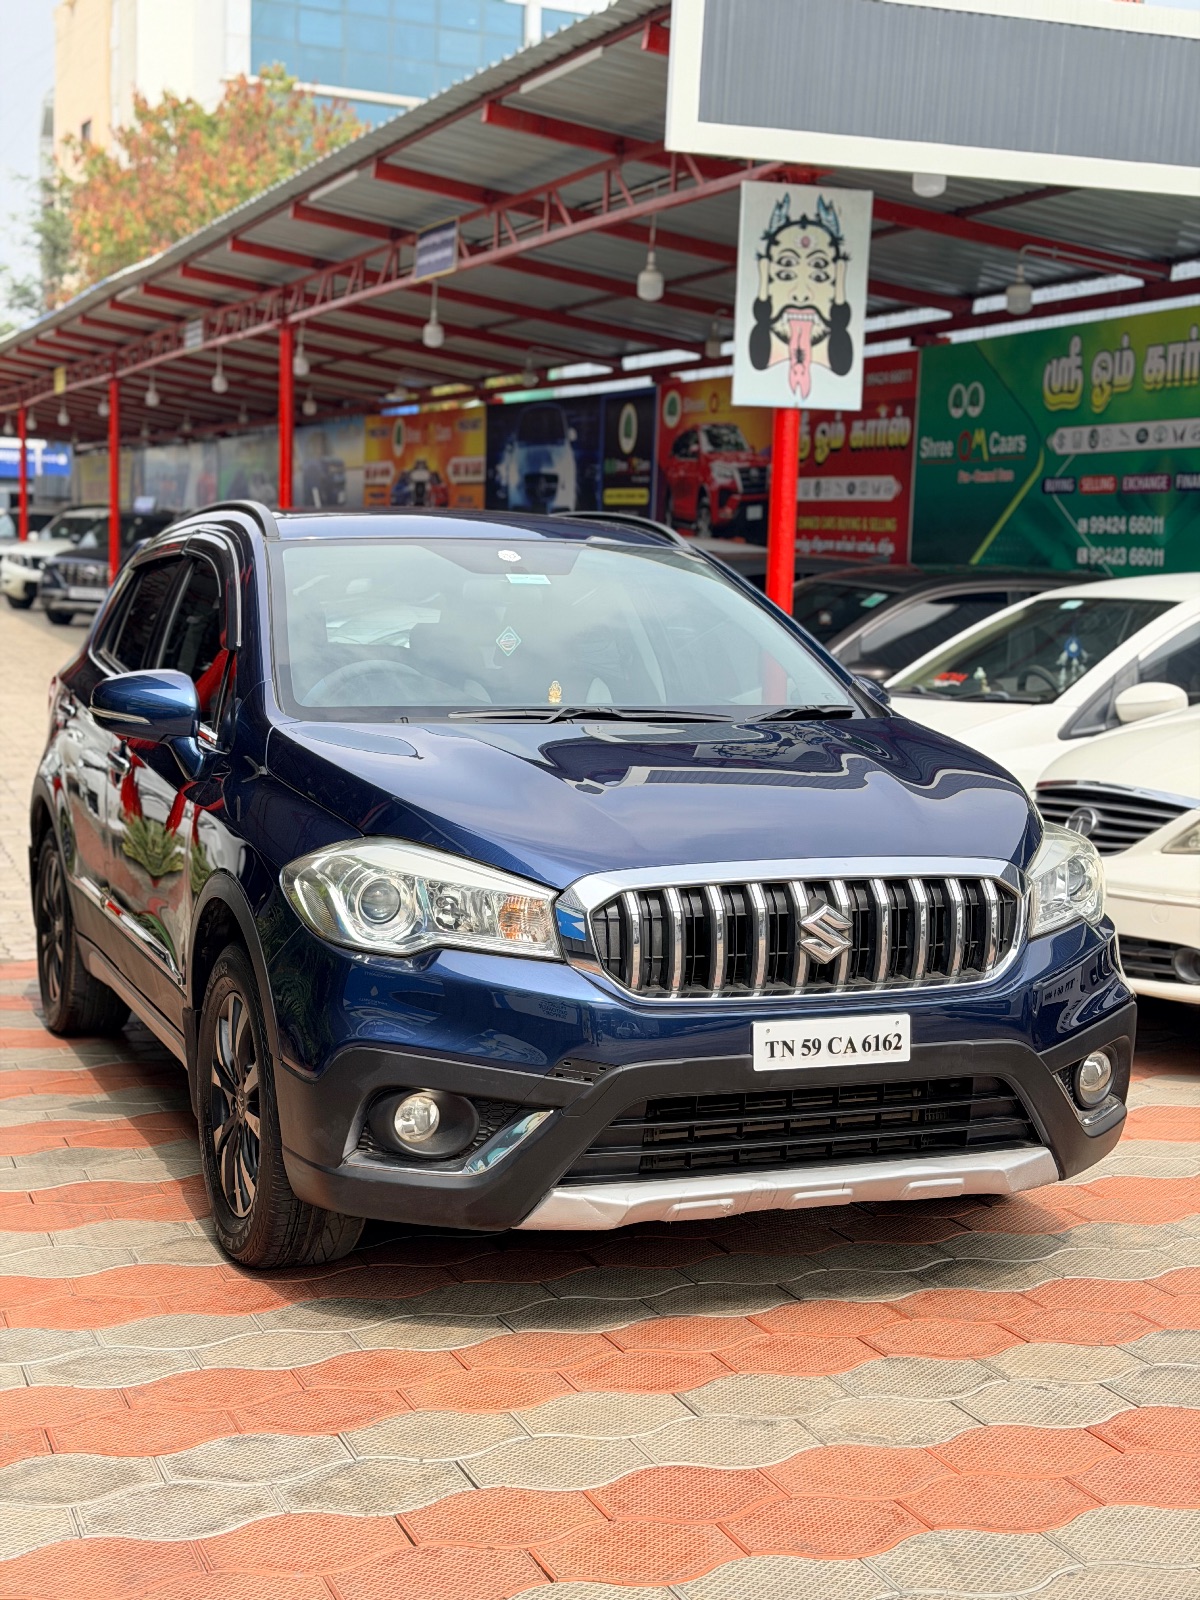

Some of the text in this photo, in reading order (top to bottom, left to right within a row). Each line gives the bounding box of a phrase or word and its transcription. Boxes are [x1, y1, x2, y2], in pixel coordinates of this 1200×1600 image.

[919, 428, 1027, 462] Shree OM Caars
[1044, 478, 1074, 492] BUYING
[1080, 476, 1115, 492] SELLING
[1122, 475, 1169, 491] EXCHANGE
[1089, 516, 1165, 534] 99424 66011
[1128, 547, 1165, 567] 66011
[765, 1033, 903, 1059] TN 59 CA 6162
